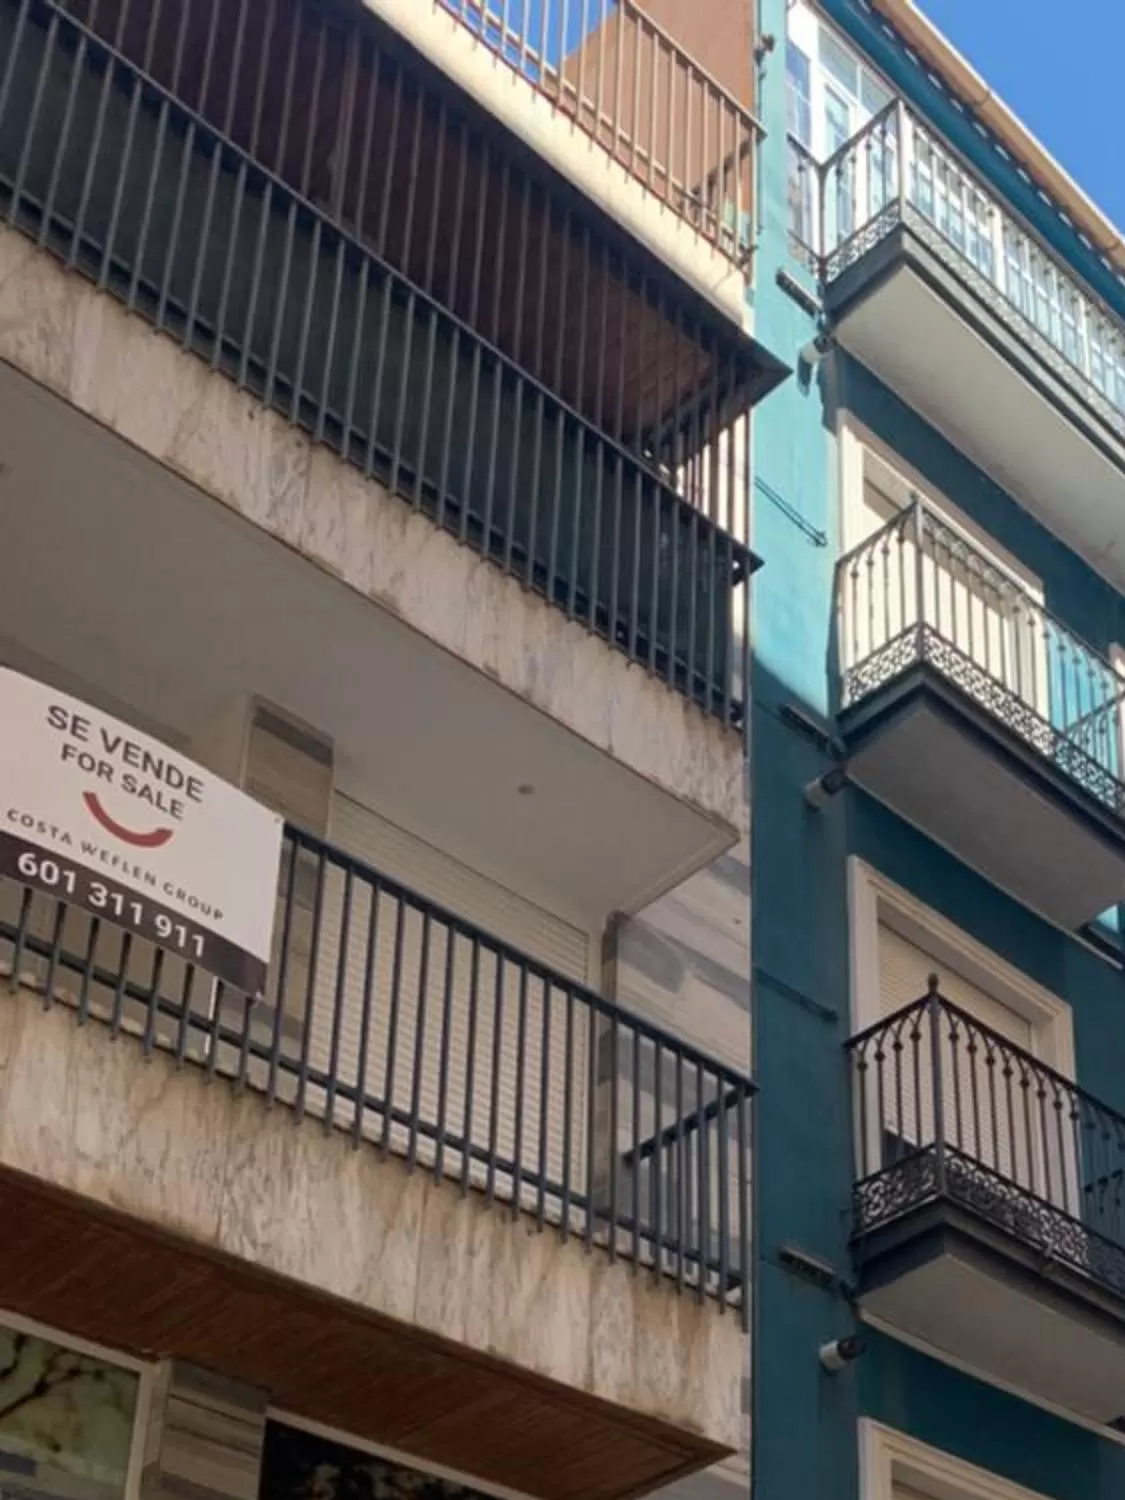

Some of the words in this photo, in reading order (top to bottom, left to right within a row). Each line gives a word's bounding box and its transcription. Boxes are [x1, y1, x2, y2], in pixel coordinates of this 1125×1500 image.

[47, 704, 91, 742] SE
[100, 727, 205, 804] VENDE
[60, 743, 114, 784] FOR
[120, 773, 184, 821] SALE
[7, 808, 73, 846] COSTA
[163, 881, 225, 921] GROUP
[17, 852, 77, 894] 601
[88, 881, 144, 926] 311
[154, 913, 206, 958] 911
